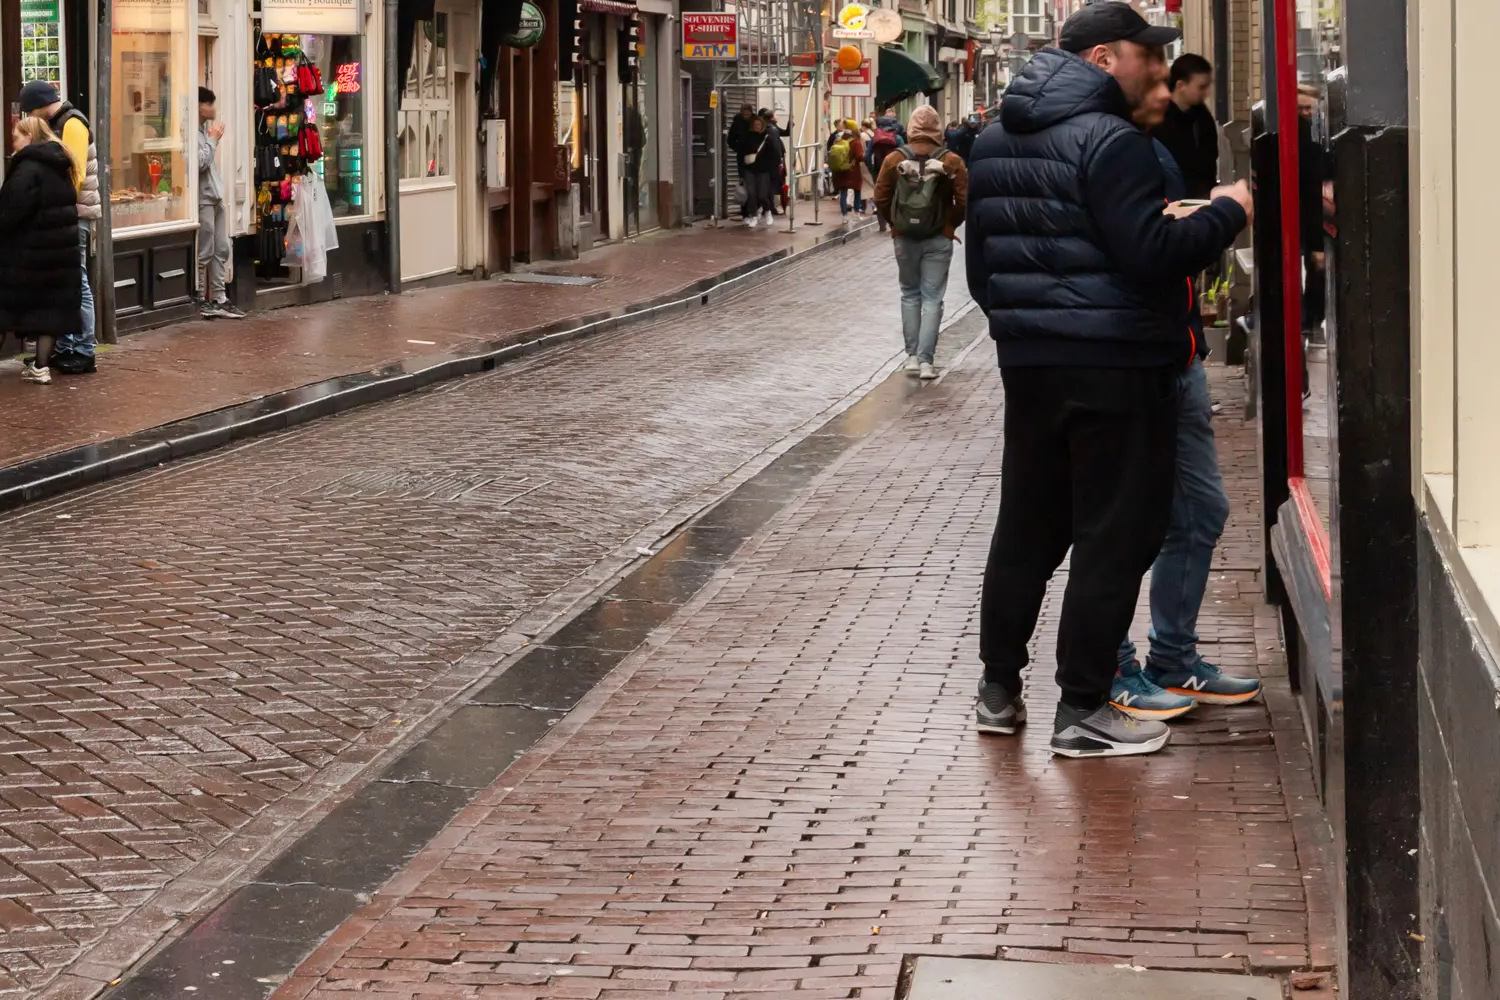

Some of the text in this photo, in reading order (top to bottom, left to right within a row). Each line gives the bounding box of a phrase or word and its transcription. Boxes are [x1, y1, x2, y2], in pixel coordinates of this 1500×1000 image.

[684, 15, 735, 23] SOUVENIRS
[692, 44, 728, 56] ATM
[338, 72, 359, 83] GET
